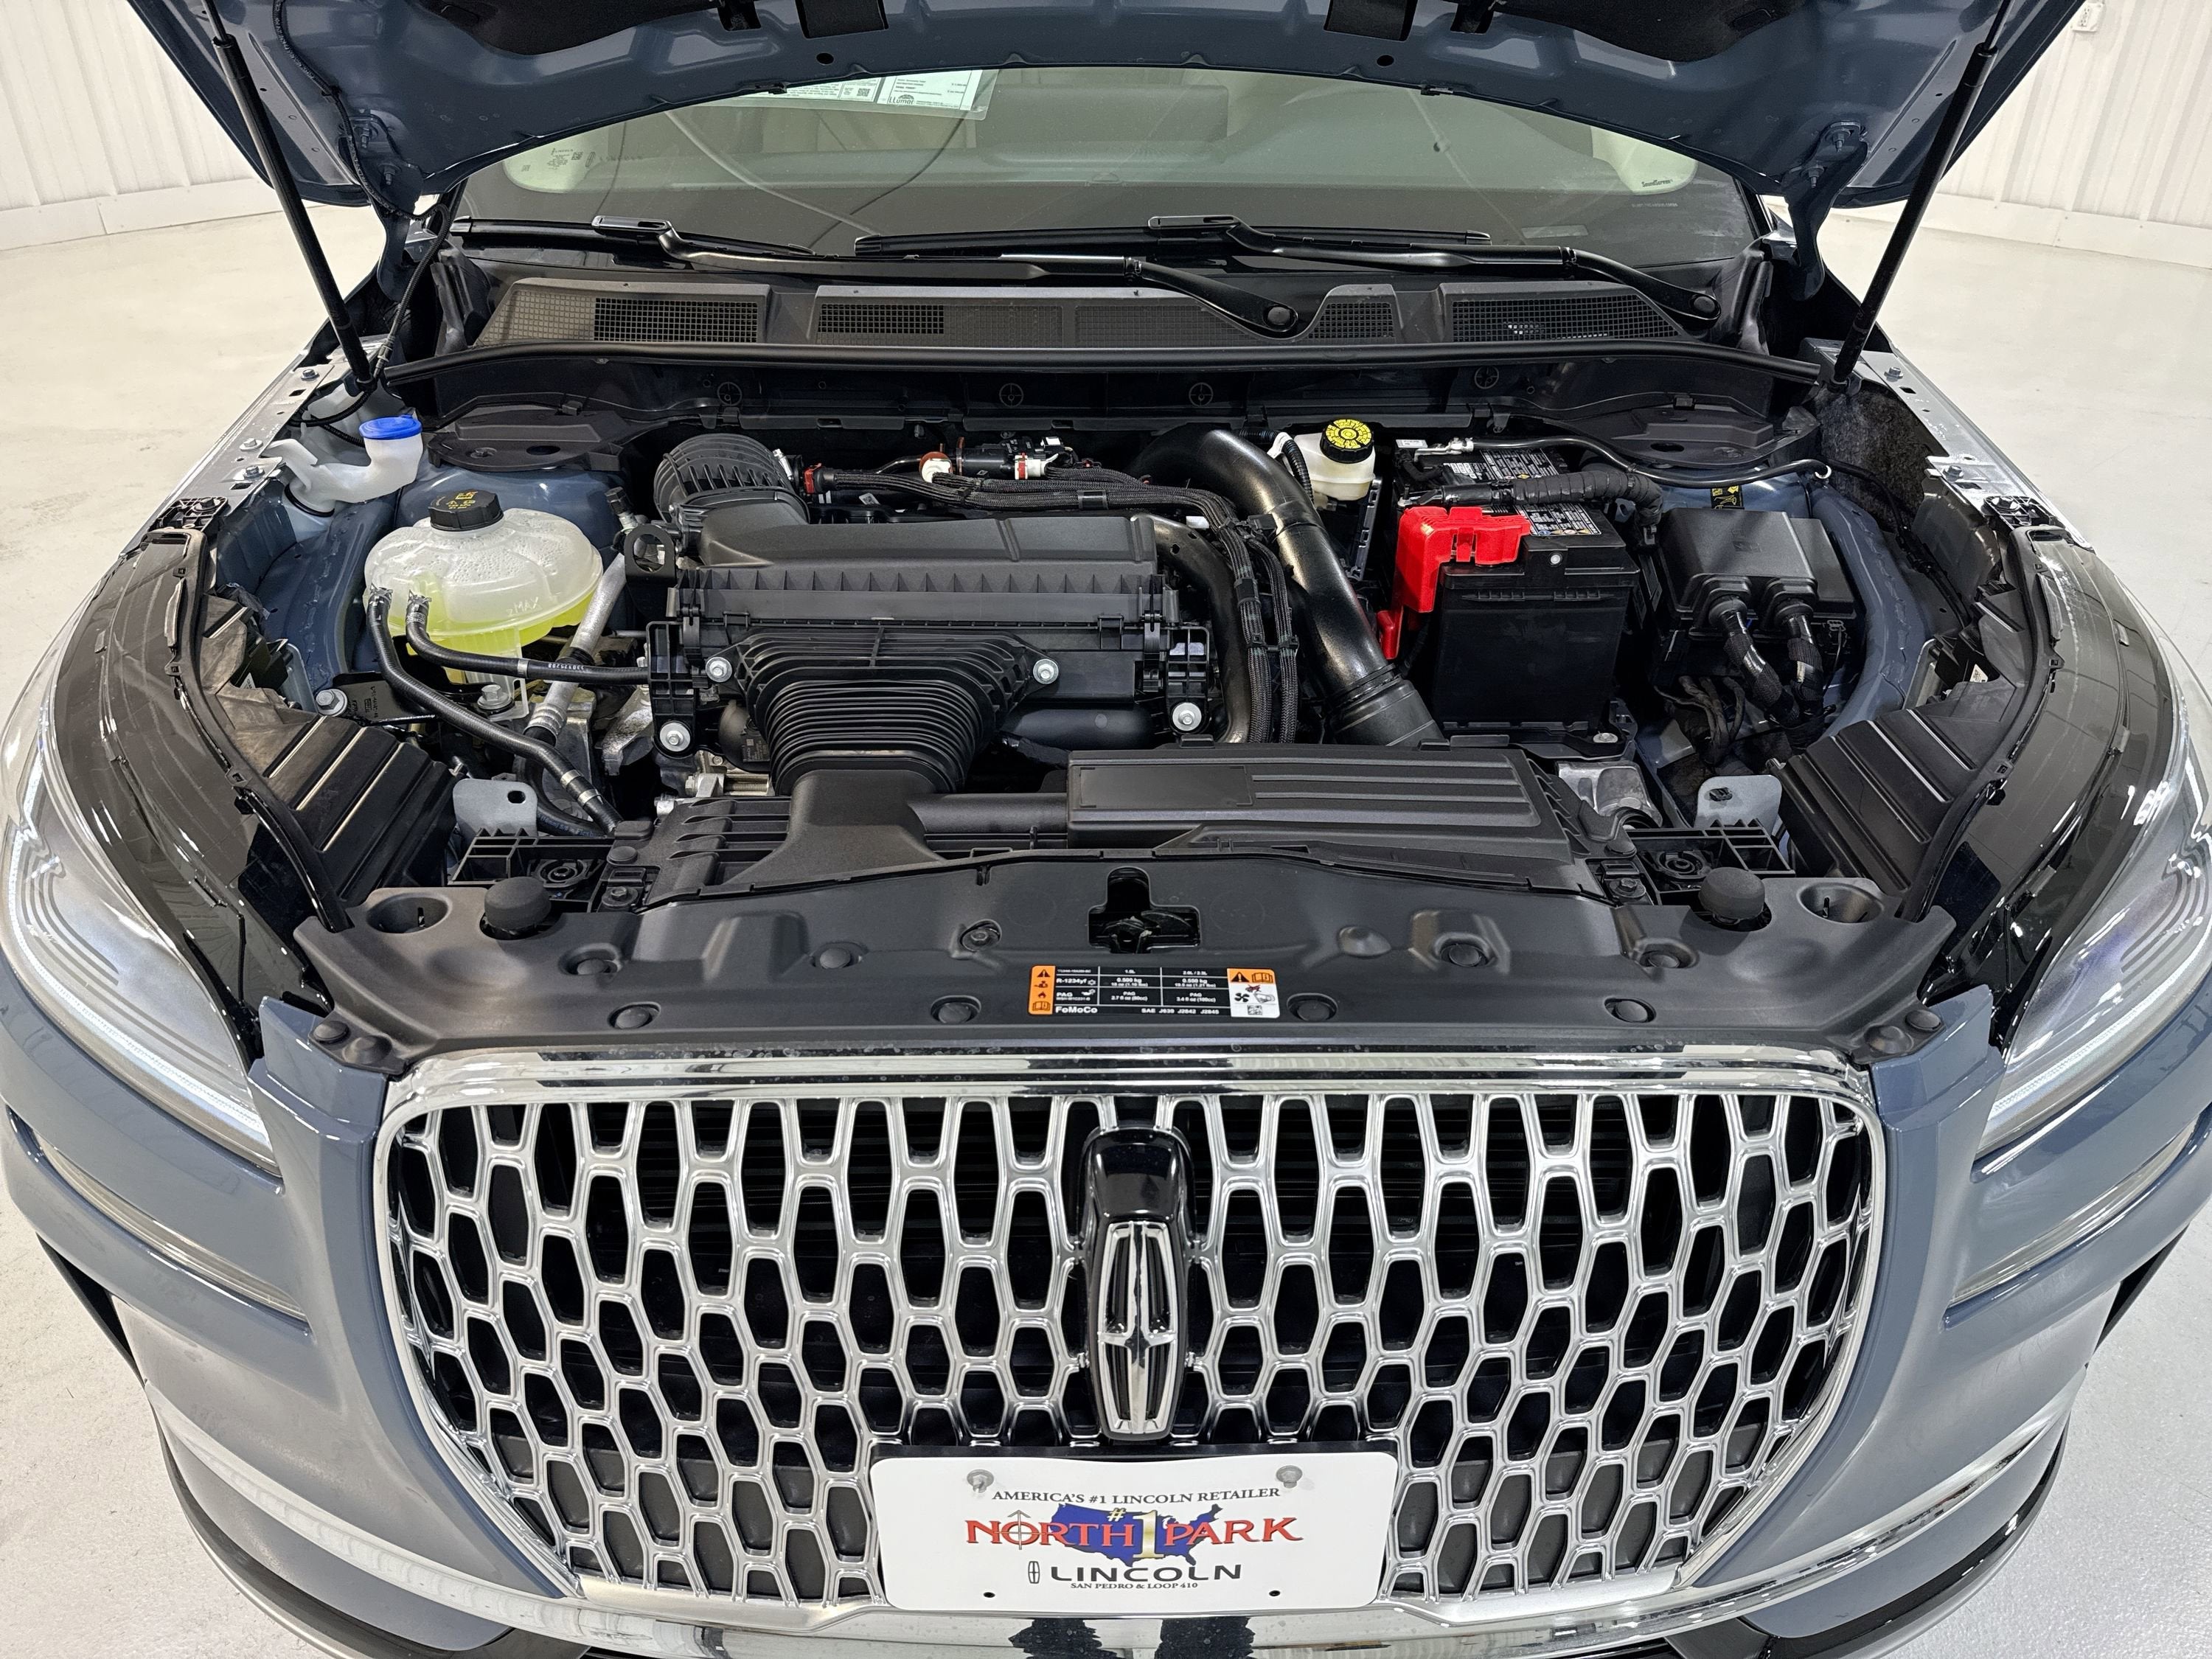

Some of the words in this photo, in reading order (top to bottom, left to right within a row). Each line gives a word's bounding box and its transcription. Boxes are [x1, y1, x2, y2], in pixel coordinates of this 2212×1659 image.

[992, 1491, 1085, 1505] AMERICA'S
[1089, 1493, 1107, 1504] #1
[1111, 1491, 1193, 1505] LINCOLN
[1197, 1486, 1280, 1502] RETAILER
[965, 1518, 1136, 1548] NORTH
[1164, 1517, 1303, 1547] PARK
[1051, 1564, 1241, 1582] LINCOLN
